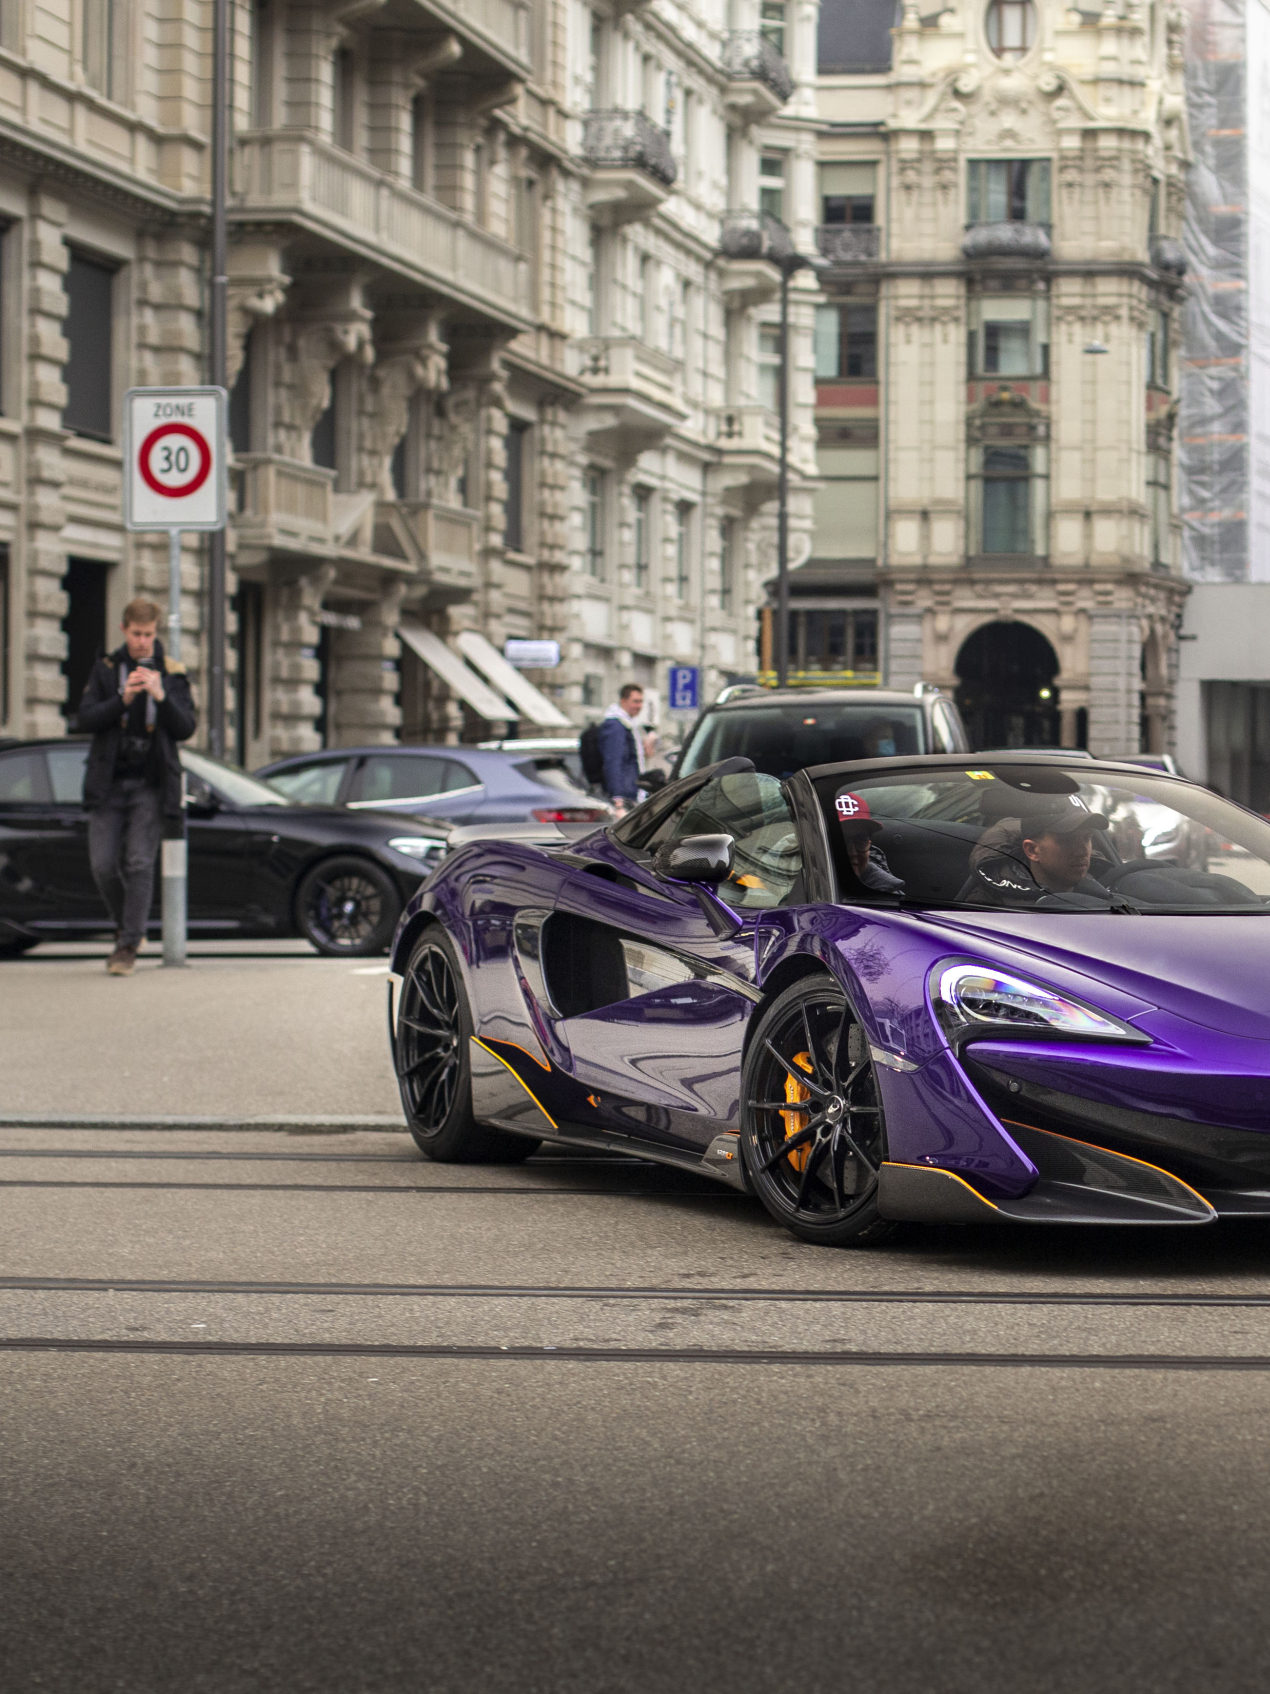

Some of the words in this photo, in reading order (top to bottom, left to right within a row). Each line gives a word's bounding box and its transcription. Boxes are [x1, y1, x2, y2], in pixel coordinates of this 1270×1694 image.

[153, 402, 196, 418] ZONE
[159, 445, 190, 474] 30
[676, 668, 692, 690] P
